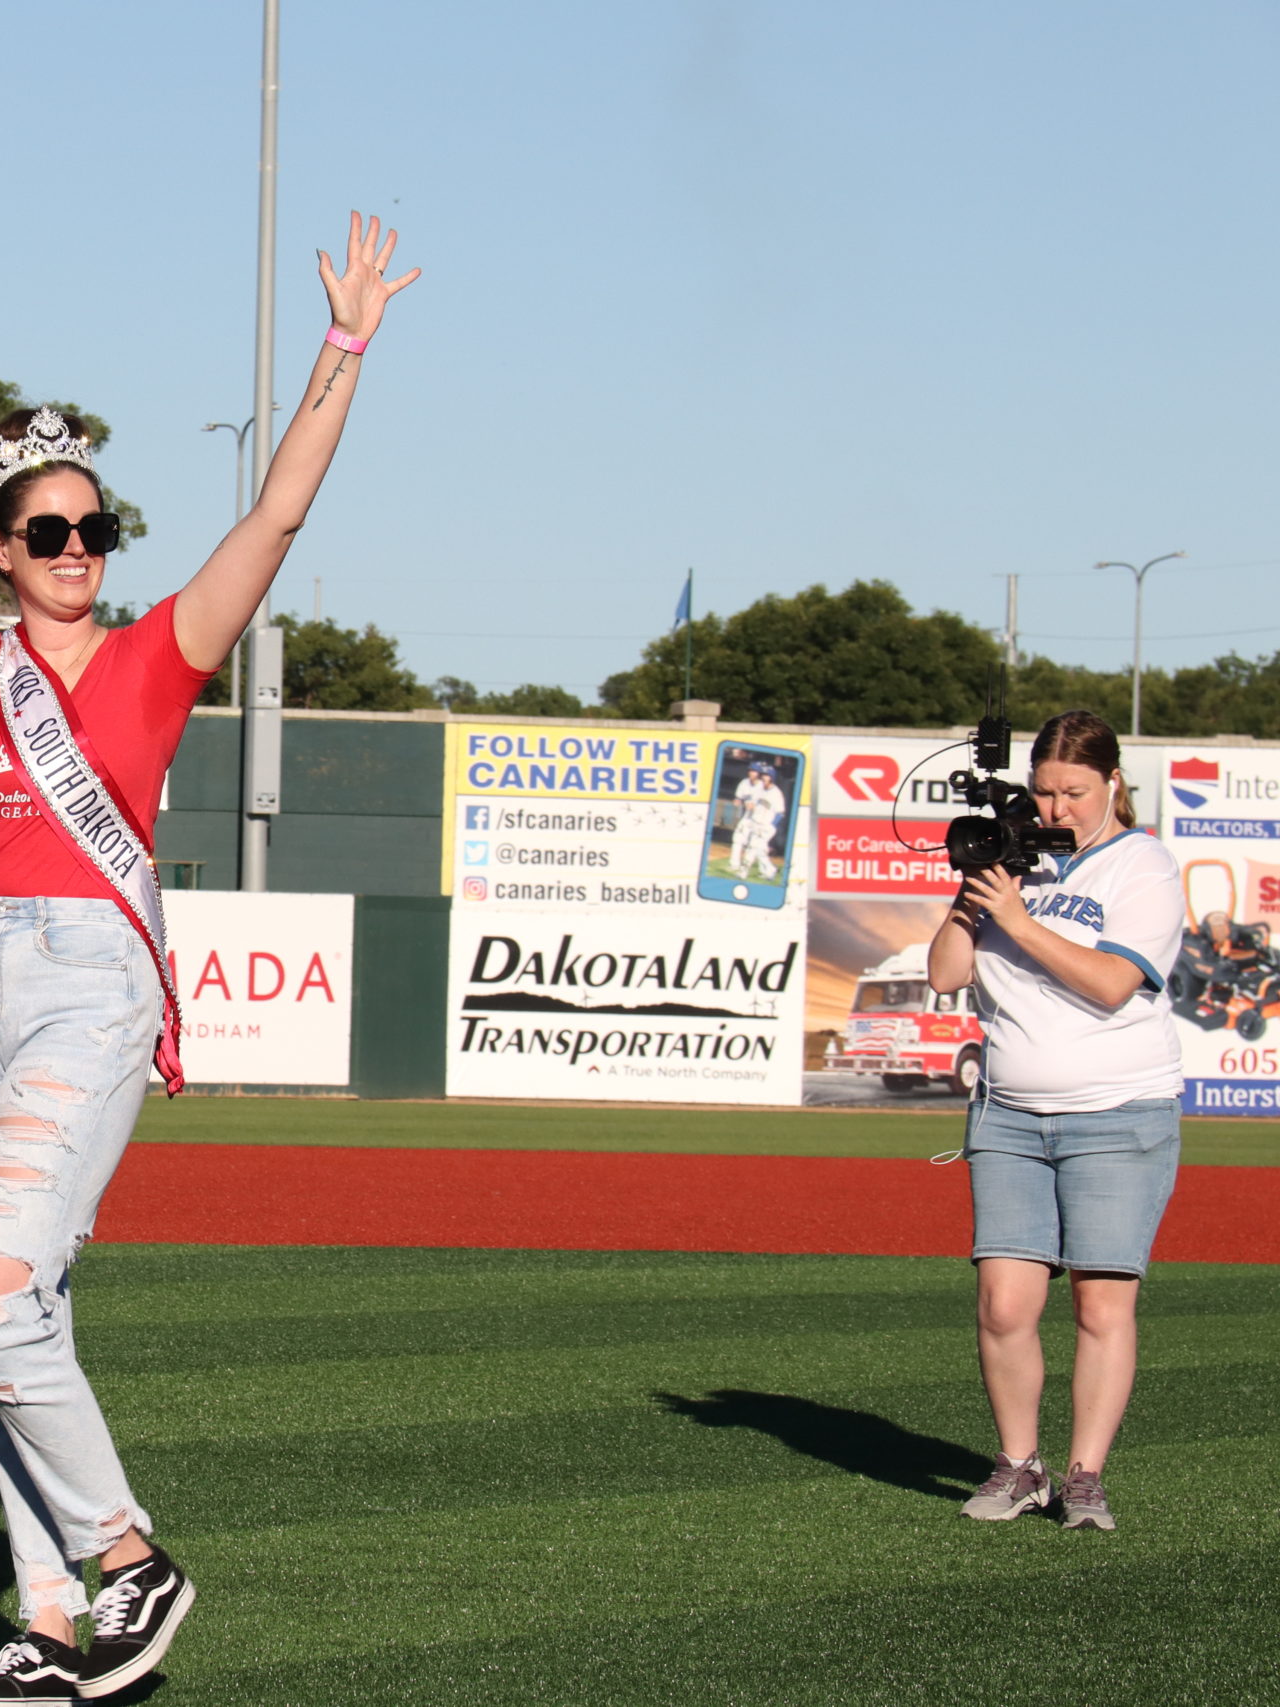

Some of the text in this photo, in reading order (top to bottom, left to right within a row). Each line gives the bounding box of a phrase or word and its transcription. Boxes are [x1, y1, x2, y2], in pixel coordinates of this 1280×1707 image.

[469, 735, 699, 763] FOLLOW THE
[468, 762, 698, 794] CANARIES!
[23, 718, 88, 798] SOUTH
[64, 790, 139, 880] DAKOTA
[496, 808, 617, 832] /sfcanaries
[1180, 820, 1269, 839] TRACTORS,
[496, 843, 609, 867] @canaries
[826, 836, 853, 851] For
[857, 837, 909, 855] Career
[608, 1065, 767, 1082] A True North Company
[1220, 1048, 1278, 1075] 605
